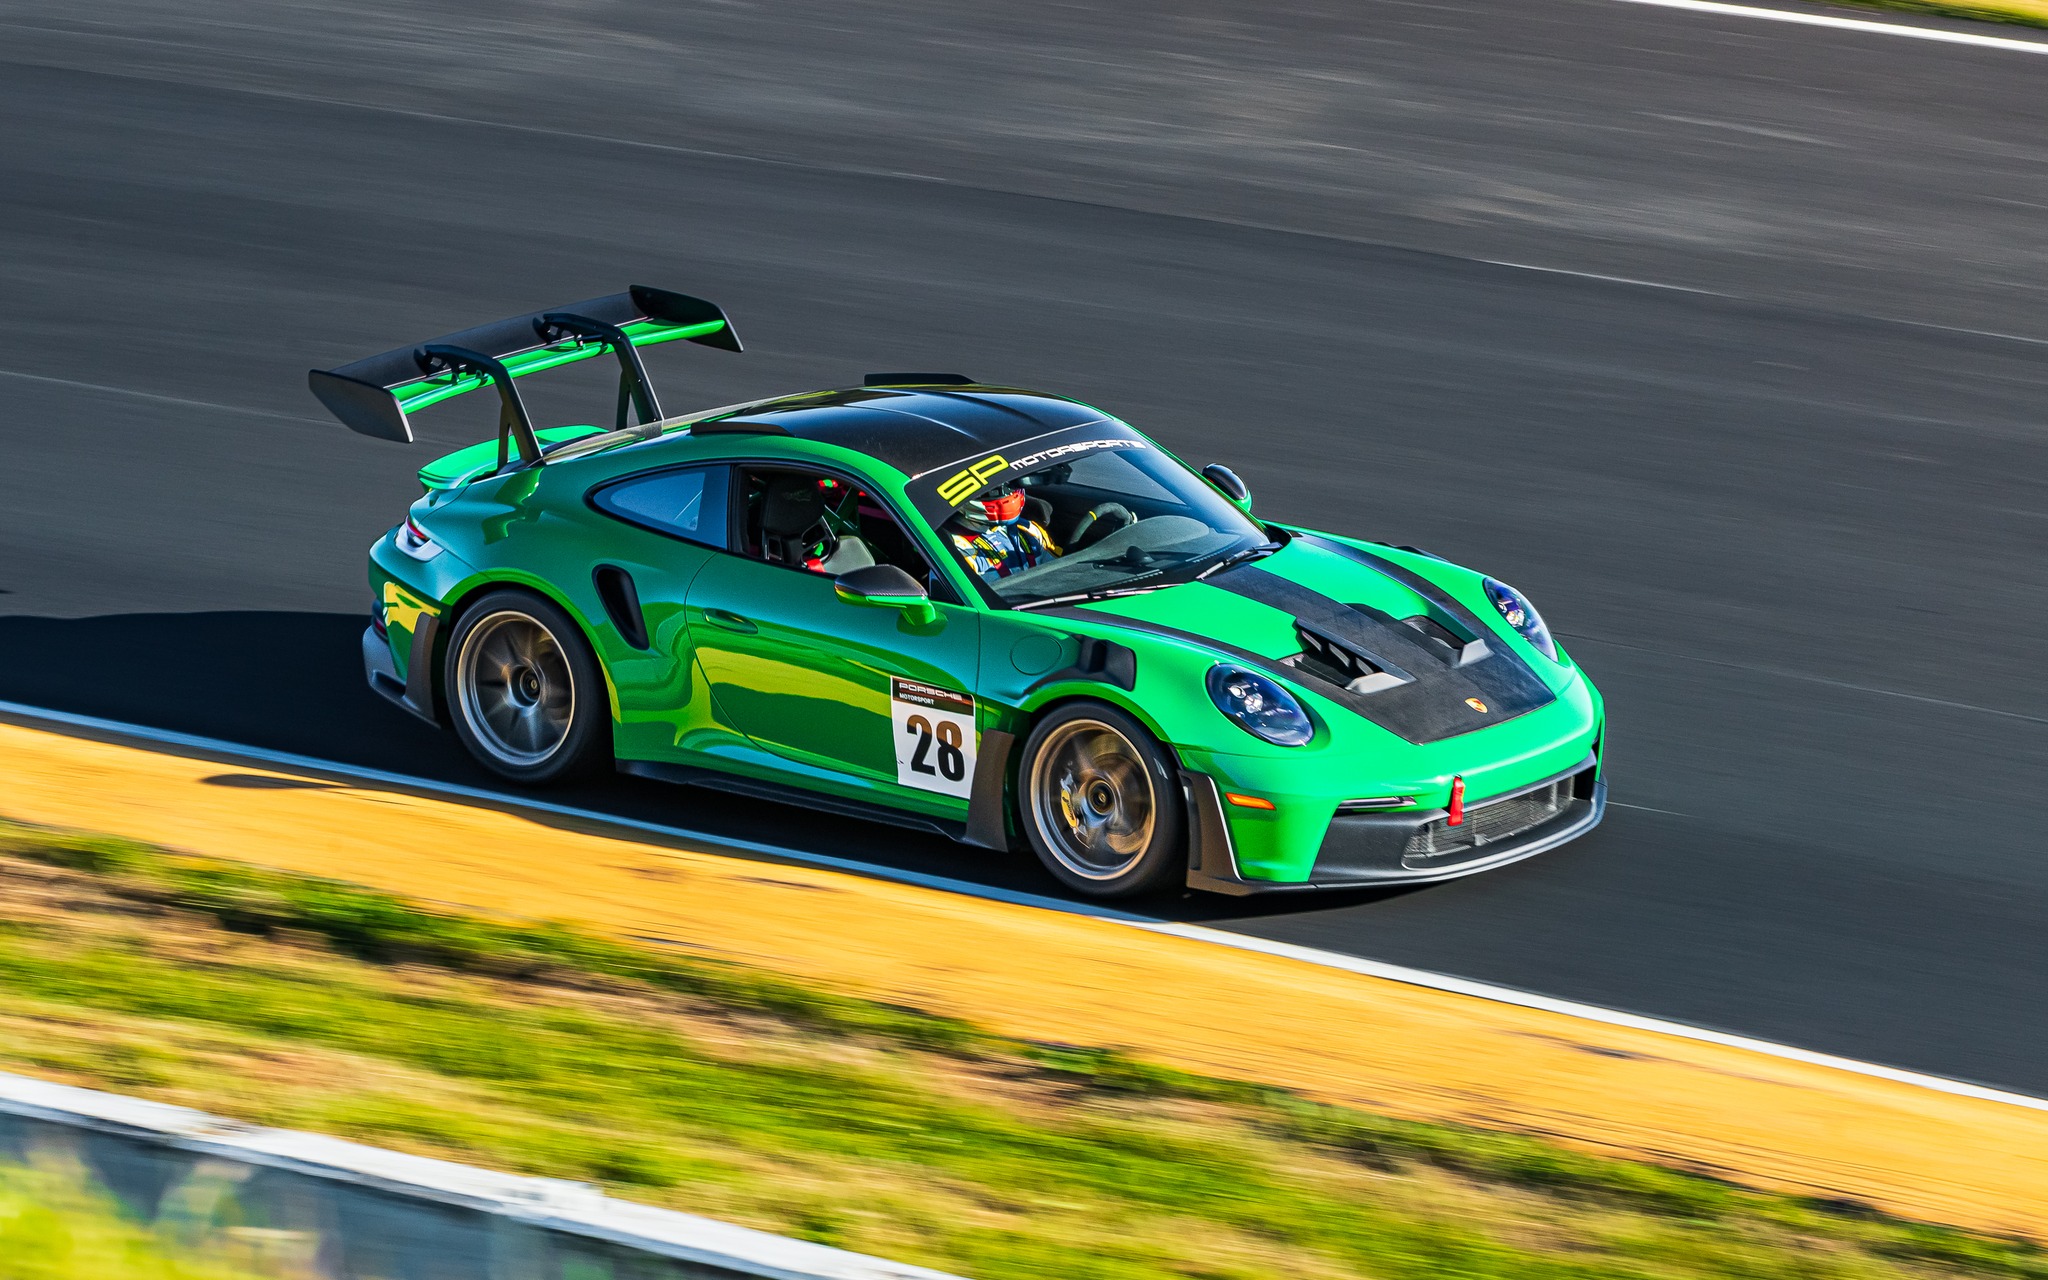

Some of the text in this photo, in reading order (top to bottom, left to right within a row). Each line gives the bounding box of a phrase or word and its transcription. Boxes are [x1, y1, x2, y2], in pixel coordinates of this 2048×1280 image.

[936, 439, 1147, 507] SP MOTORSPORTS
[898, 682, 963, 701] PORSCHE
[898, 692, 935, 706] MOTORSPORT
[906, 714, 965, 782] 28
